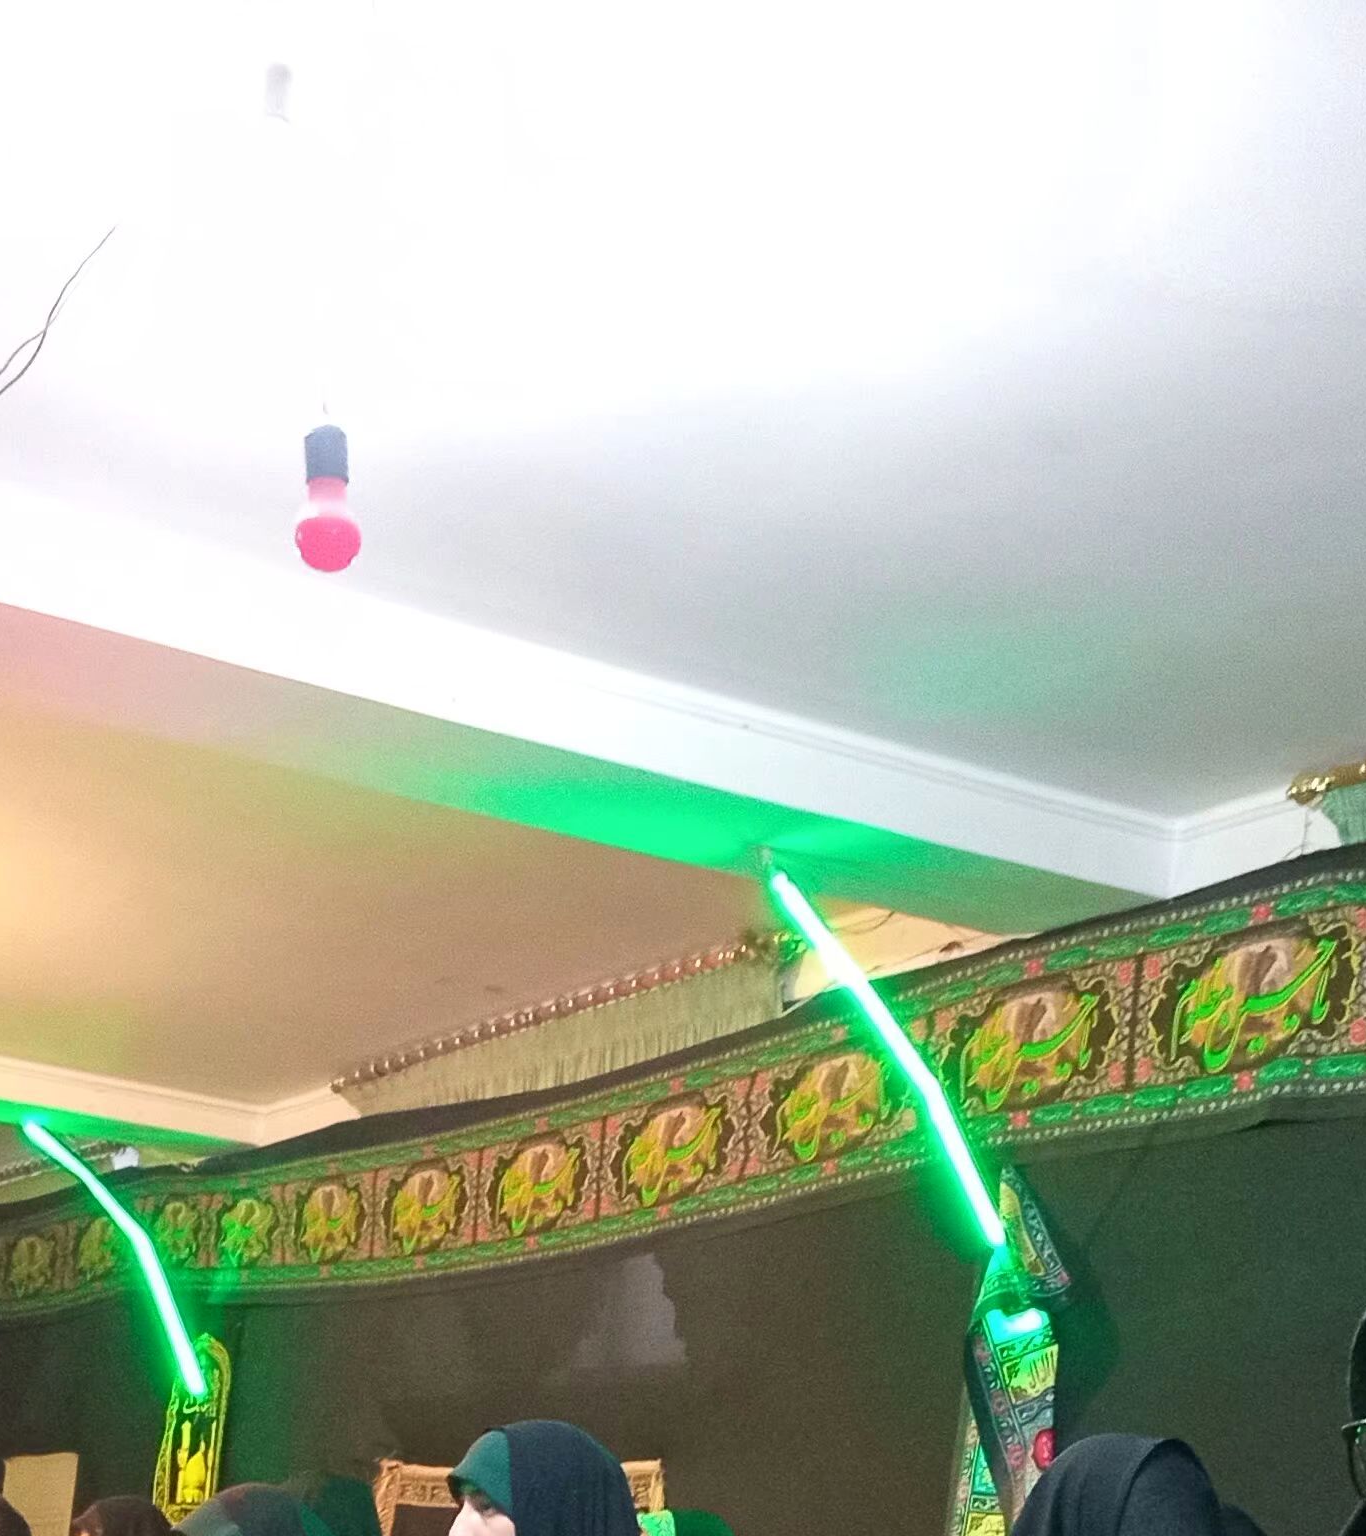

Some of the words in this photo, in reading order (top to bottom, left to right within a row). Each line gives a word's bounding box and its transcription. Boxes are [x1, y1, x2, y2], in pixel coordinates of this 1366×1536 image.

[986, 992, 1100, 1112] حسین
[1170, 957, 1234, 1062] مظلوم
[1203, 938, 1337, 1073] حسین
